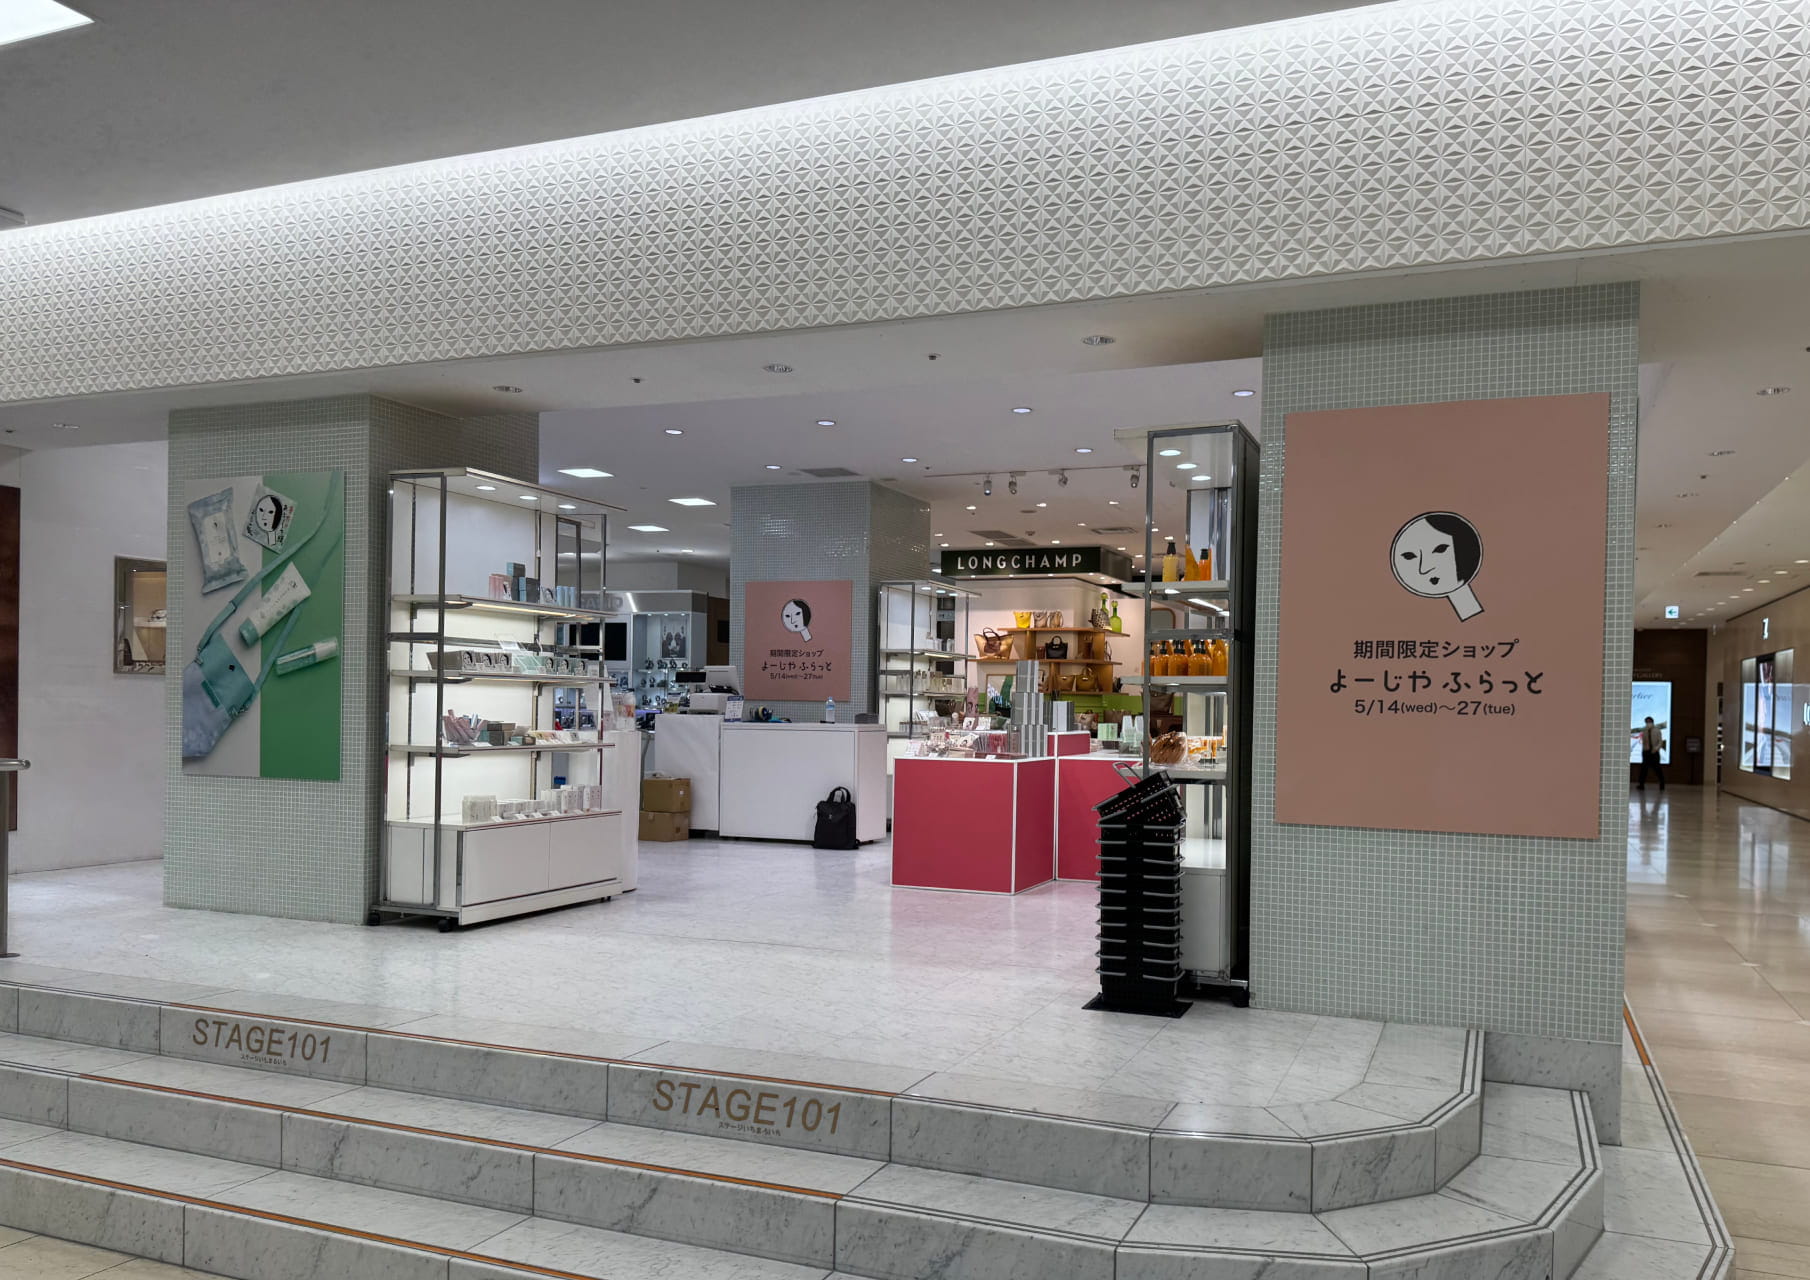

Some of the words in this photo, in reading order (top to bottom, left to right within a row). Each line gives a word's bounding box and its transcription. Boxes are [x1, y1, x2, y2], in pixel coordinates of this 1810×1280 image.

[957, 553, 1082, 570] LONGCHAMP
[1353, 638, 1520, 660] 期間限定ショップ
[761, 661, 796, 672] よーじや
[799, 661, 832, 672] ふらっと
[1329, 669, 1432, 694] よーじや
[1442, 670, 1544, 695] ふらっと
[192, 1018, 331, 1064] STAGE101
[652, 1079, 842, 1135] STAGE101
